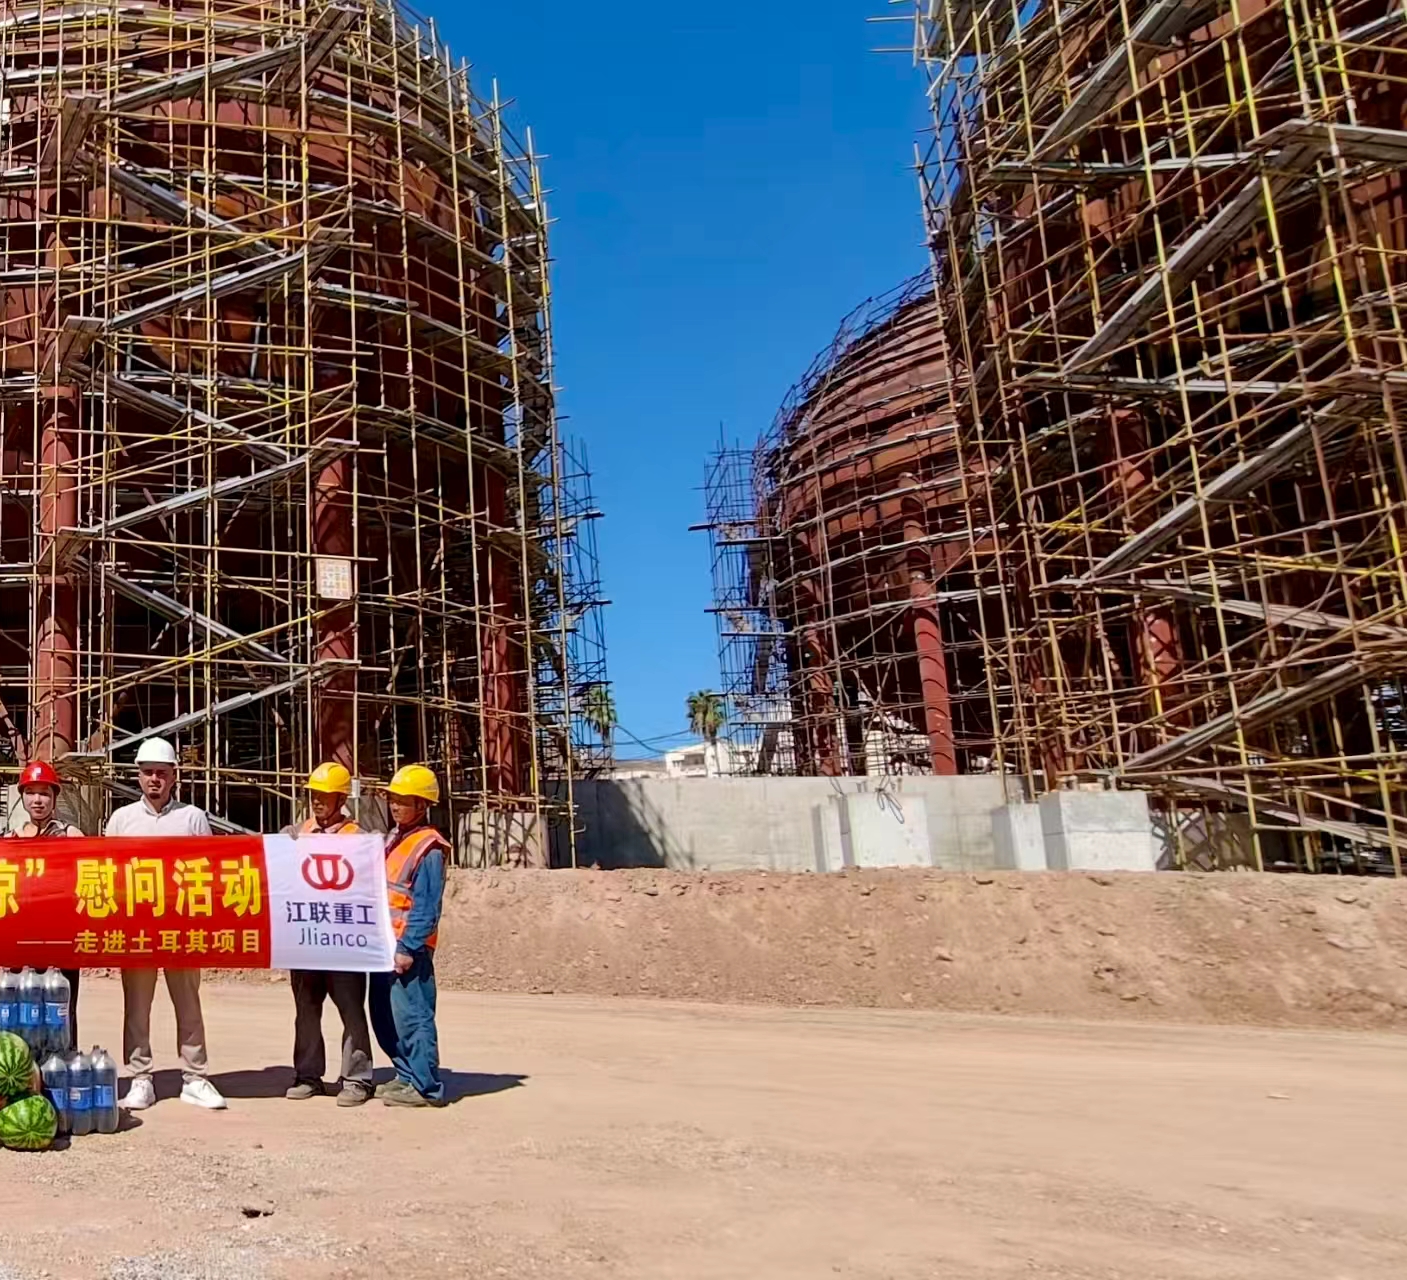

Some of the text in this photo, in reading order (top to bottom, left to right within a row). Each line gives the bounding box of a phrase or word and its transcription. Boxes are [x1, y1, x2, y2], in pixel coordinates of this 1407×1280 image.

[75, 852, 261, 918] 慰问活动
[285, 900, 376, 925] 江联重工
